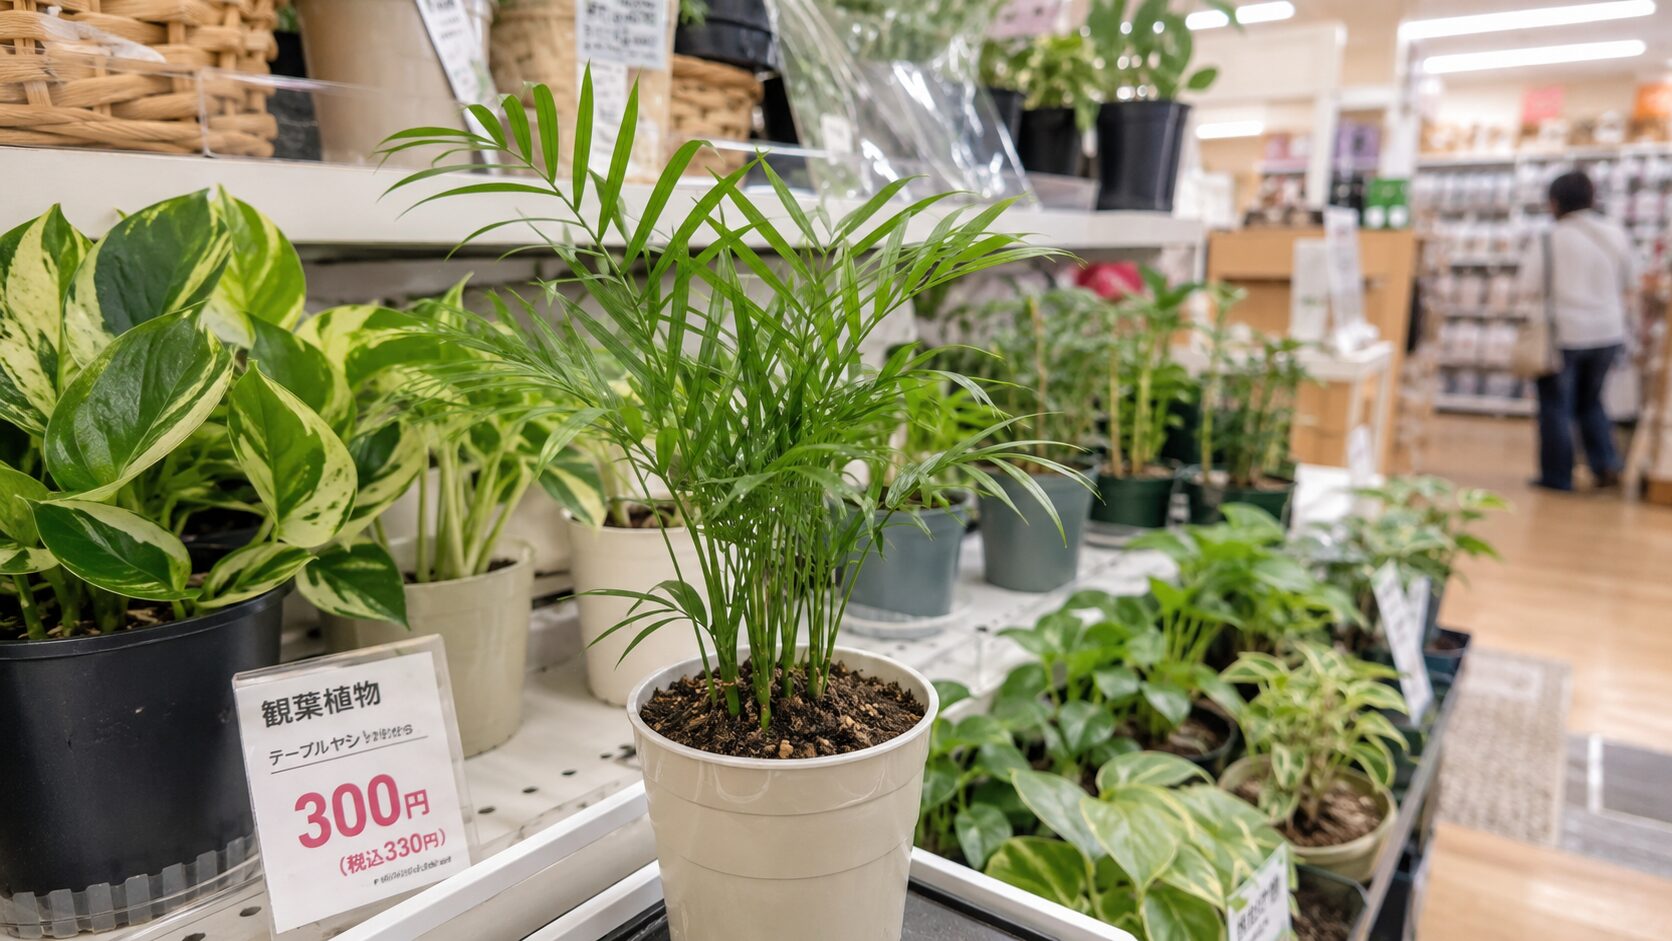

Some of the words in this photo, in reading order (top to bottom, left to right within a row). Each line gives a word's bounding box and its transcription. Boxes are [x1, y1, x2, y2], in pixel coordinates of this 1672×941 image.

[261, 680, 381, 728] 観葉植物
[294, 773, 430, 849] 300円
[339, 828, 446, 876] (税込330円)
